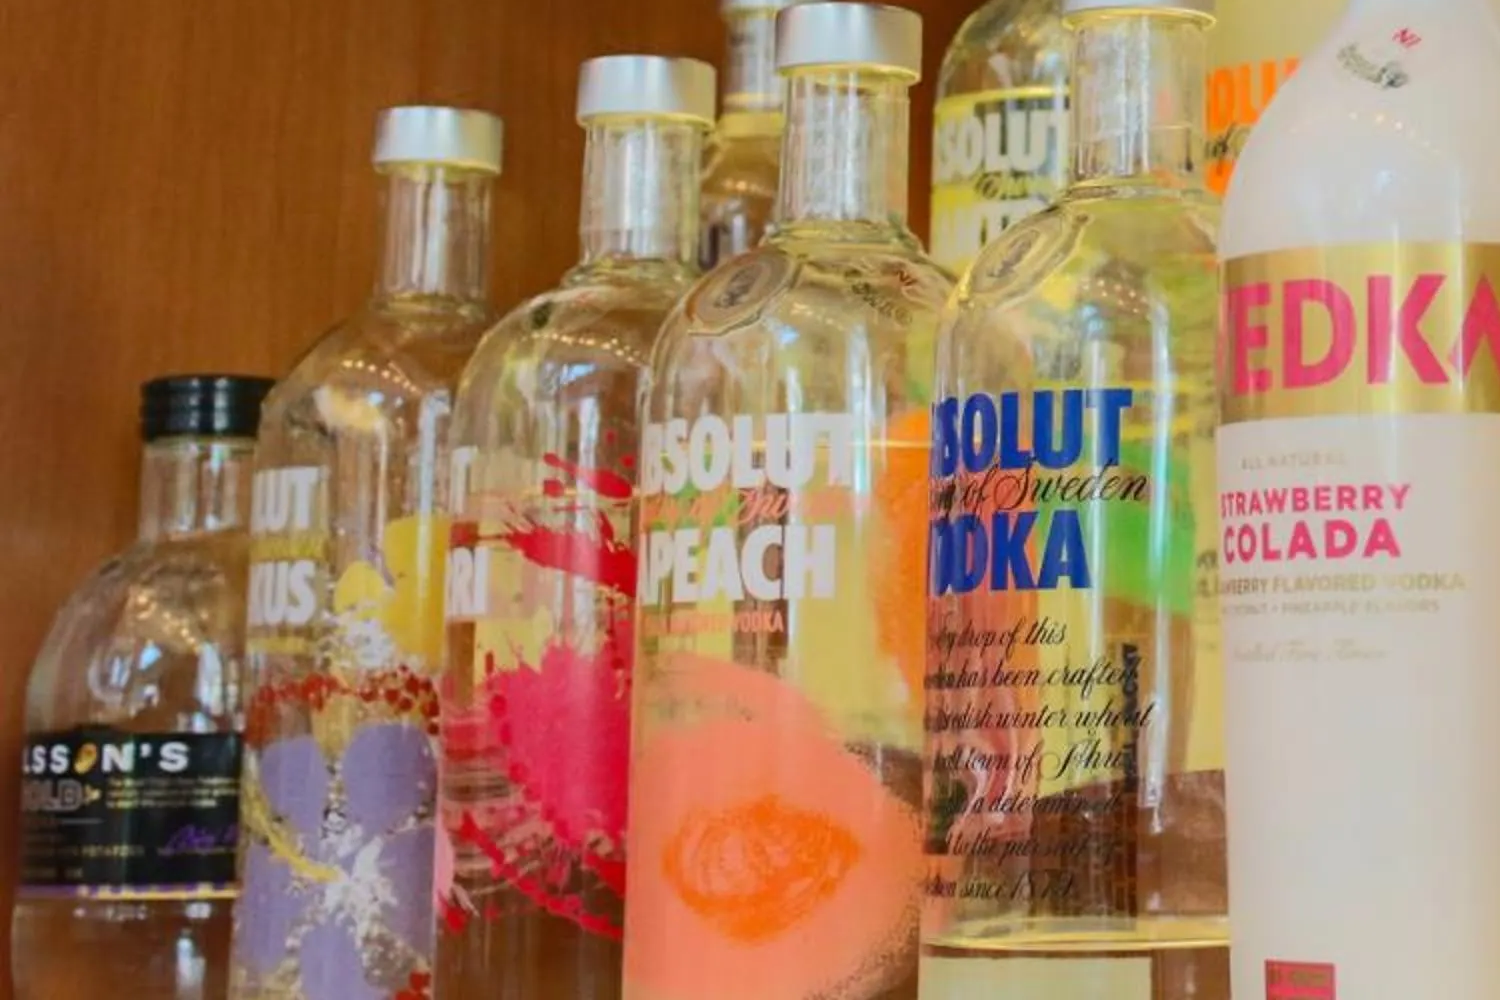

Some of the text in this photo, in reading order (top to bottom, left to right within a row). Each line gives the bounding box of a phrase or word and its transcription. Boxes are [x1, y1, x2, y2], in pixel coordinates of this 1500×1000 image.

[993, 456, 1148, 511] Sweden
[1220, 483, 1412, 519] STRAWBERRY
[1223, 517, 1402, 565] COLADA
[1025, 616, 1067, 646] this
[991, 661, 1041, 687] been
[998, 703, 1069, 730] winter
